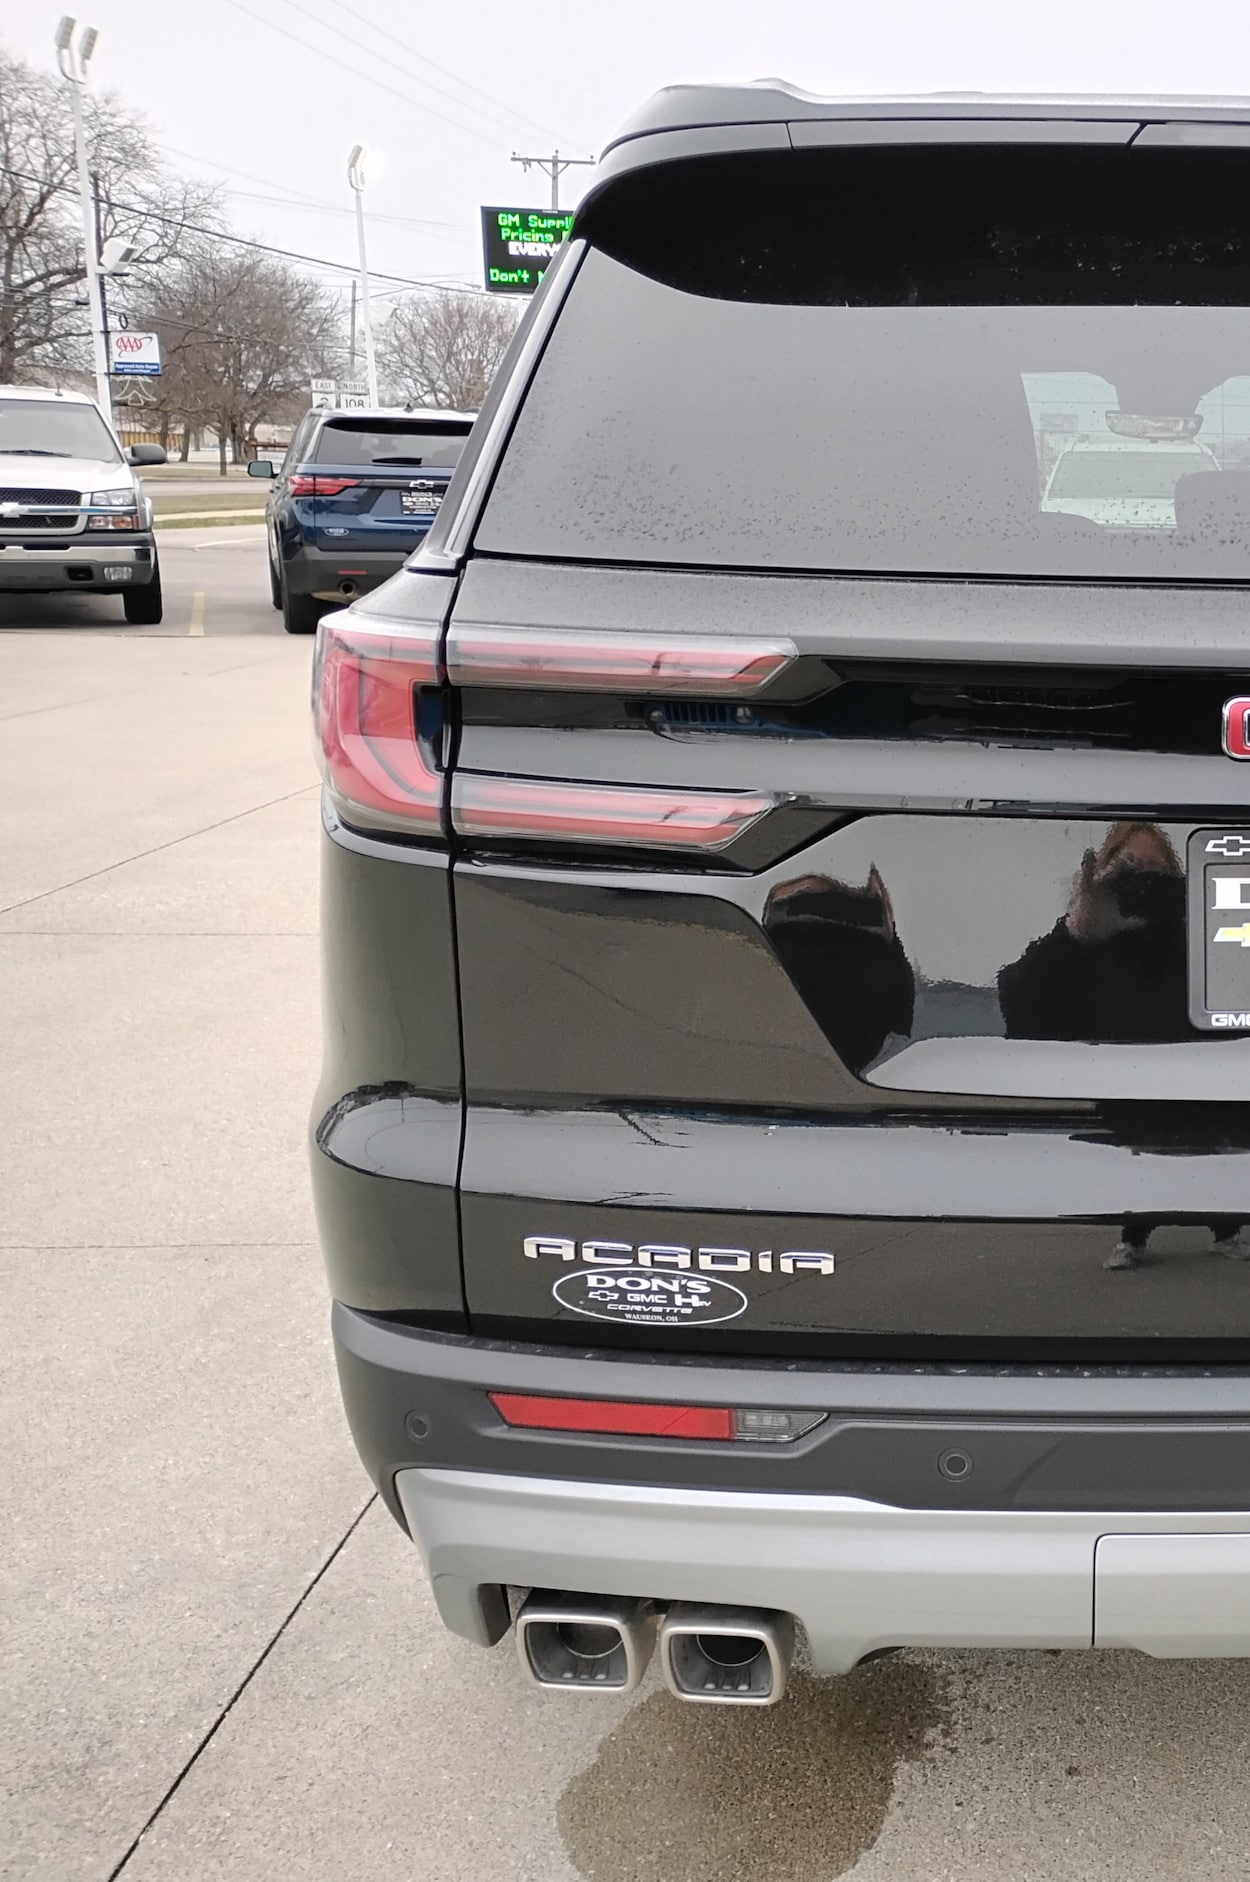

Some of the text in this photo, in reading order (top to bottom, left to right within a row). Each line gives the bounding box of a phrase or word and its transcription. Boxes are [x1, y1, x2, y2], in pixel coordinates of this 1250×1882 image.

[497, 213, 520, 226] GM
[501, 228, 554, 243] Pricing
[489, 268, 529, 283] Don't
[117, 336, 142, 352] AAA
[315, 381, 331, 389] EAST
[343, 382, 365, 391] NORTH
[345, 398, 365, 408] 108
[523, 1235, 836, 1276] ACADIA
[586, 1274, 712, 1294] DON'S
[626, 1293, 668, 1304] GMC
[606, 1303, 693, 1314] CORVETTE
[624, 1313, 665, 1322] WAUSEON,
